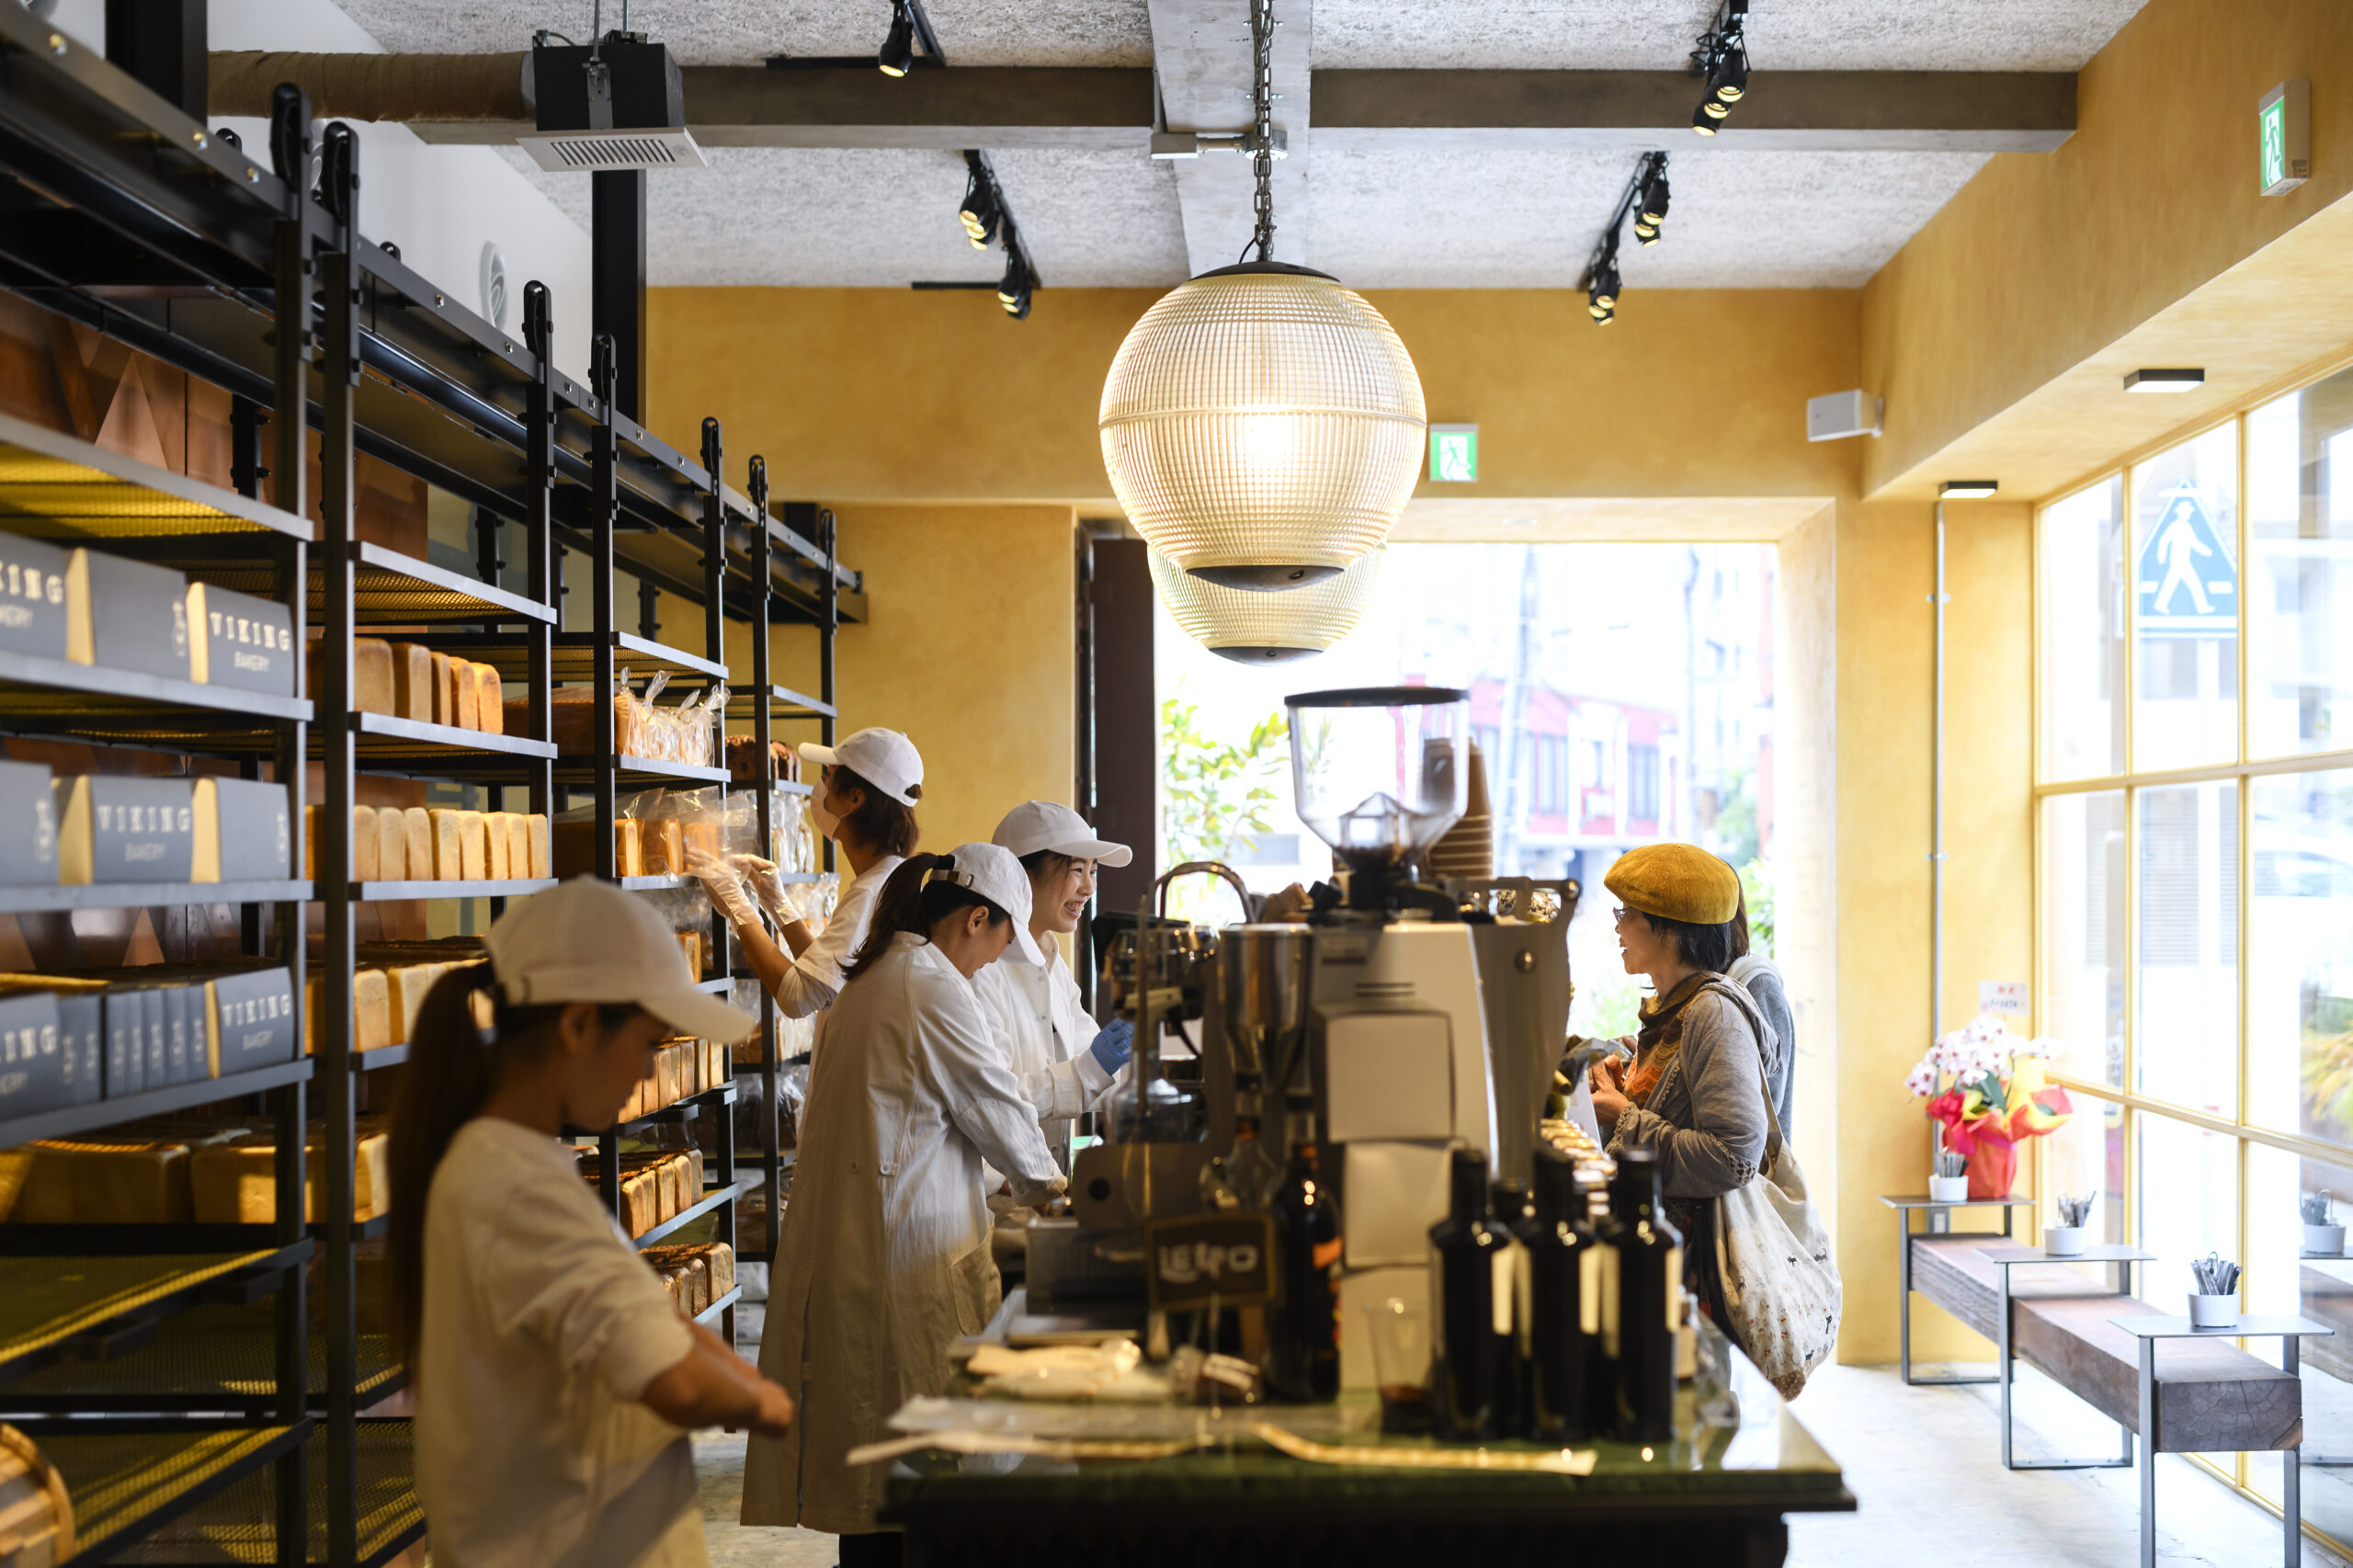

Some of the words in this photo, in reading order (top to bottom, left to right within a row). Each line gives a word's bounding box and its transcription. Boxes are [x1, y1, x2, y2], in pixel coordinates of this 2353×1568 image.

[210, 611, 291, 652] VIKING
[97, 804, 191, 833] VIKING
[222, 993, 292, 1028] VIKING
[0, 1025, 57, 1063] ING
